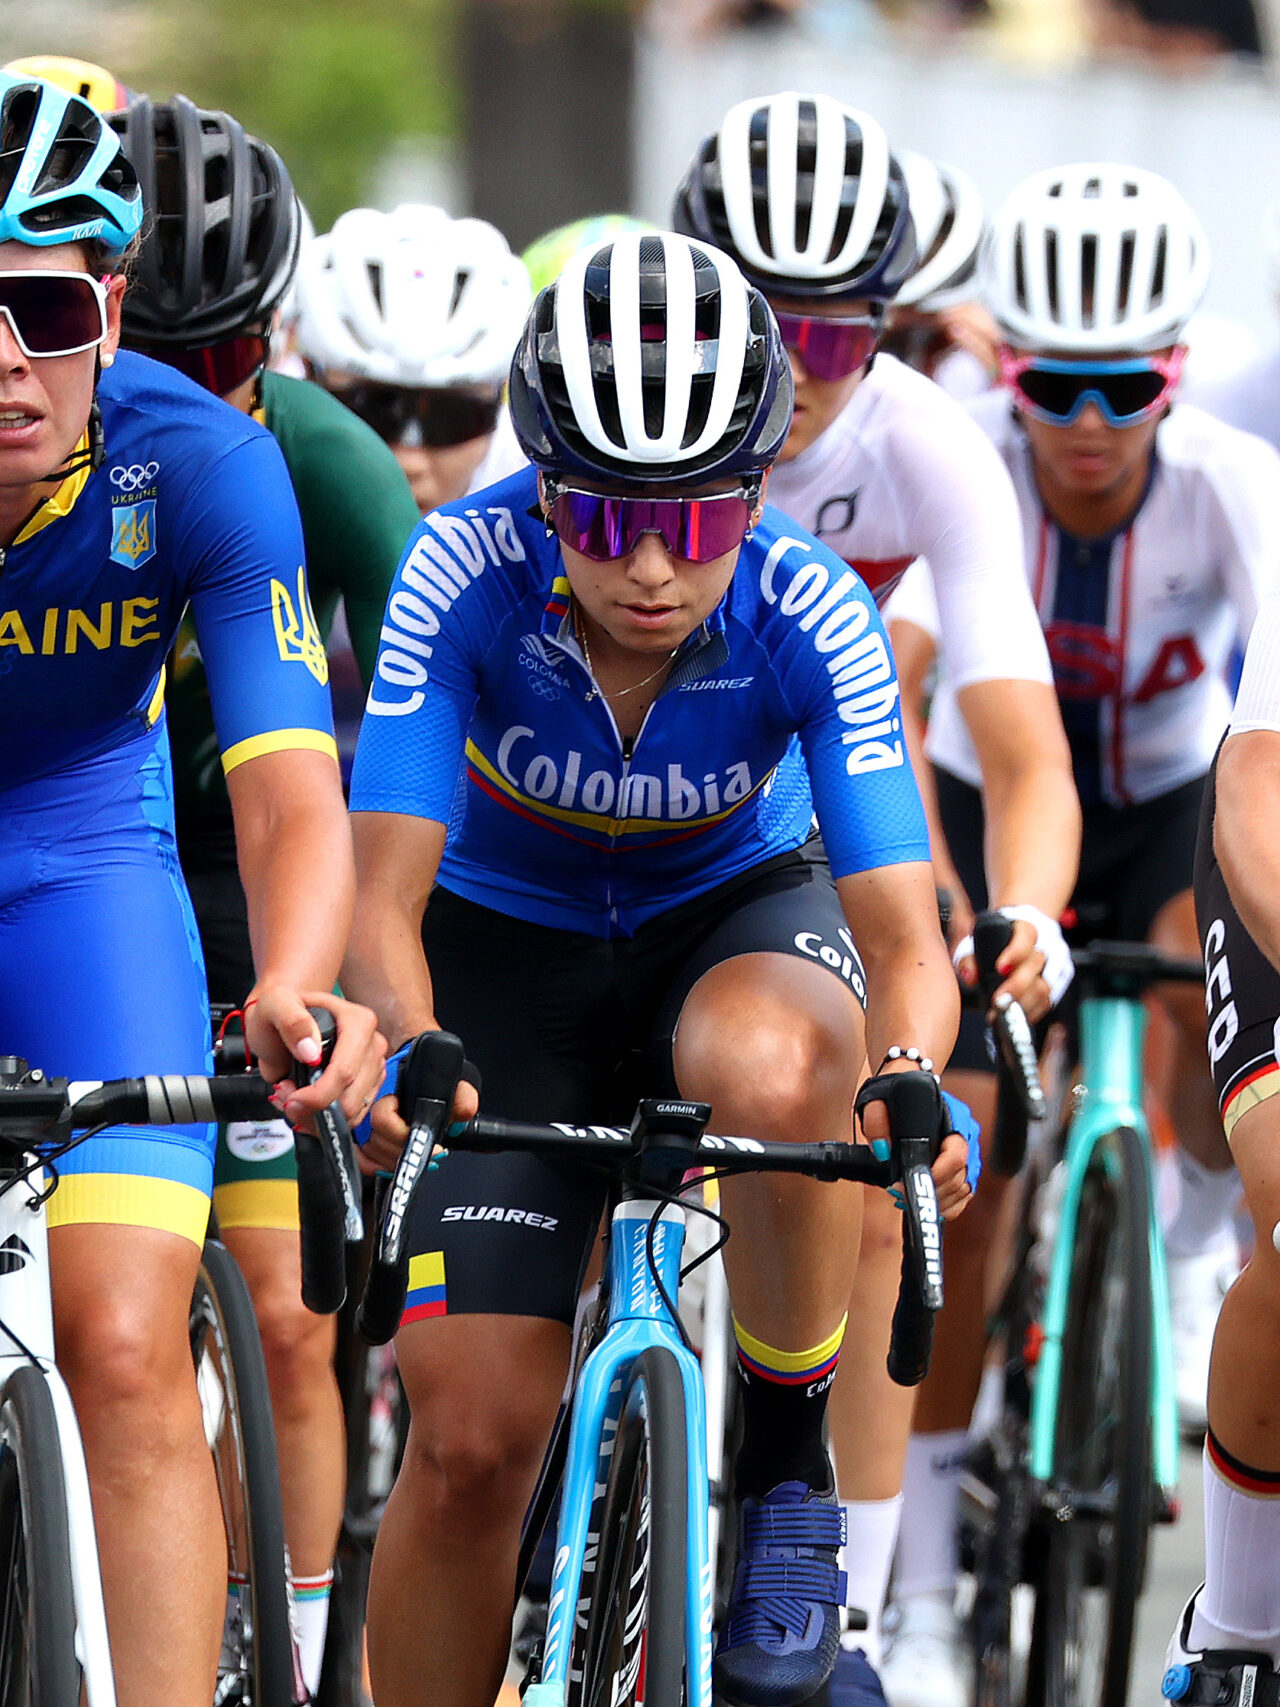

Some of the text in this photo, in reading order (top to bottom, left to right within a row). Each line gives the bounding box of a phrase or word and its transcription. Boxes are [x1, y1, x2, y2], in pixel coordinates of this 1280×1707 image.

[0, 597, 161, 656] AINE
[365, 506, 526, 716] Colombia
[760, 535, 904, 776] Colombia
[678, 676, 755, 693] SUAREZ
[497, 725, 753, 820] Colombia
[656, 1103, 697, 1115] GARMIN
[386, 1128, 429, 1240] SRAM
[440, 1206, 559, 1232] SUAREZ
[913, 1172, 943, 1286] SRAM
